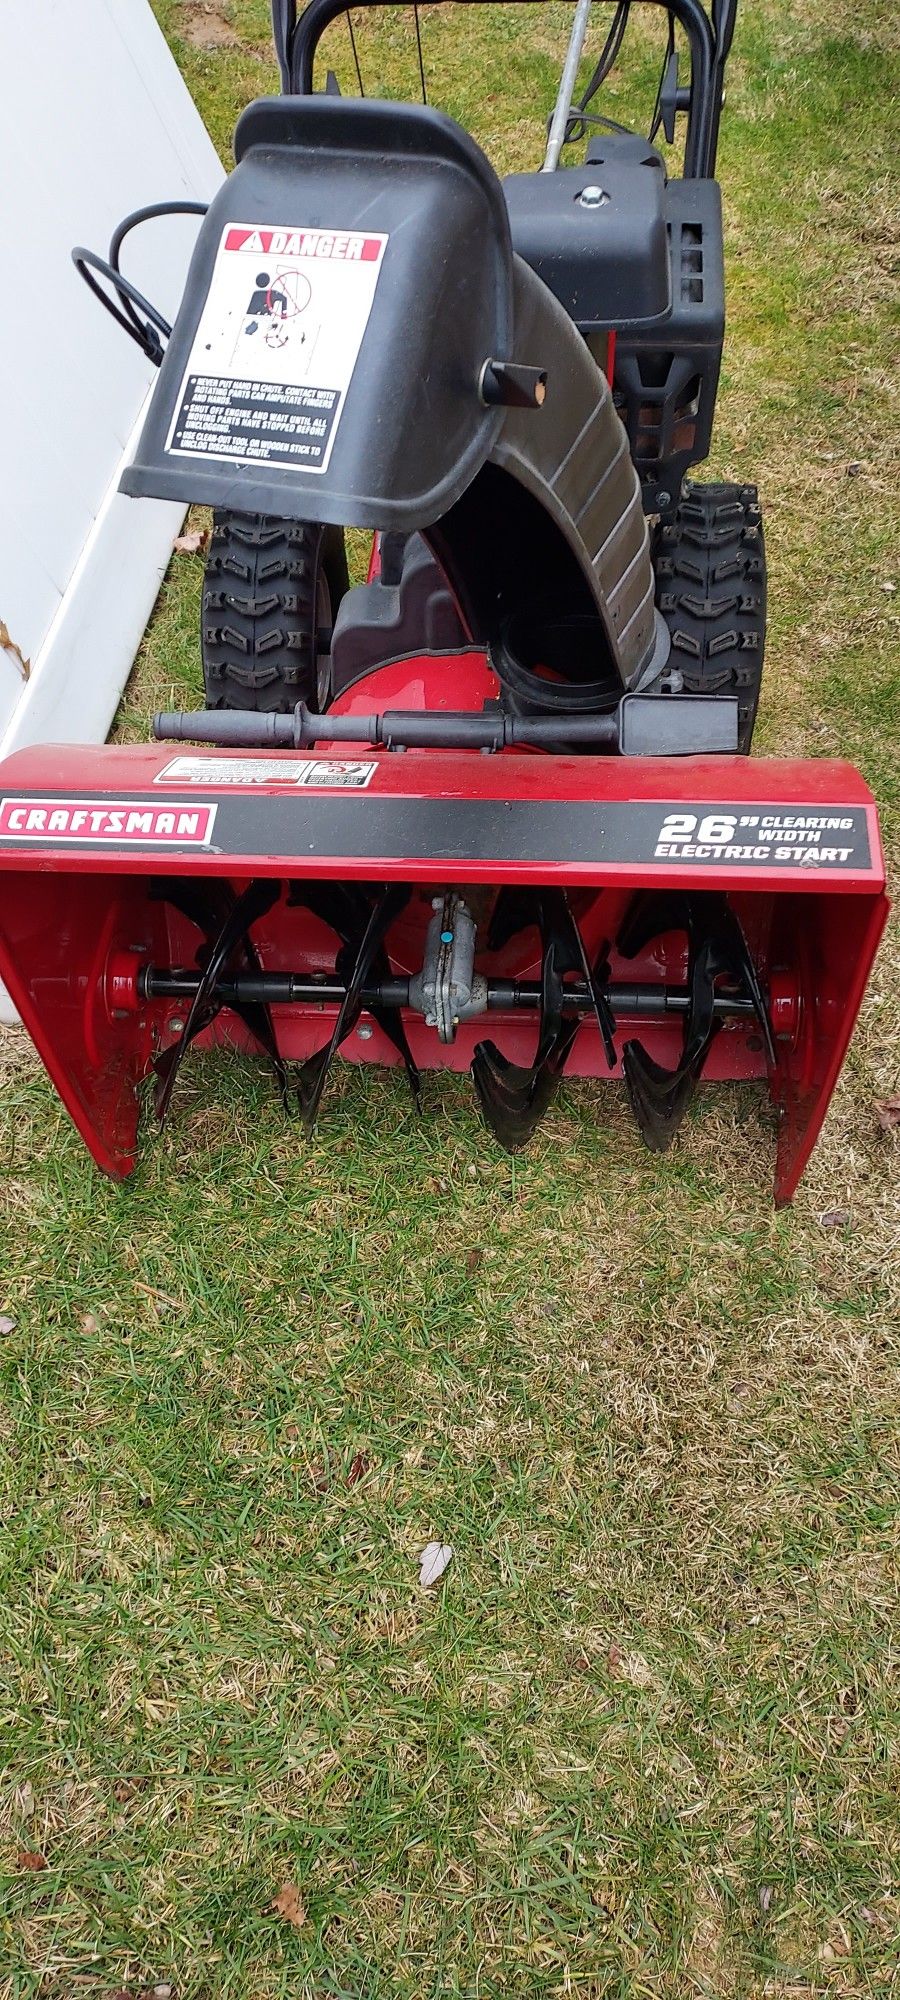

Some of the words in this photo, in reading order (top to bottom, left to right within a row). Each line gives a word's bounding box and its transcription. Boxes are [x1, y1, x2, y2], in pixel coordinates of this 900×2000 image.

[269, 231, 365, 261] DANGER
[192, 393, 207, 403] AND
[194, 385, 228, 396] ROTATING
[228, 388, 251, 399] PARTS
[251, 391, 266, 401] CAN
[265, 393, 303, 406] AMPUTATE
[302, 397, 333, 409] FINGERS
[197, 377, 219, 387] NEVER
[219, 380, 233, 389] PUT
[232, 381, 252, 391] HAND
[252, 383, 261, 392] IN
[260, 384, 284, 394] CHUTE.
[285, 386, 318, 398] CONTACT
[317, 390, 336, 401] WITH
[185, 420, 231, 433] UNCLOGGING.
[187, 412, 216, 423] MOVING
[216, 415, 241, 426] PARTS
[241, 418, 261, 429] HAVE
[261, 420, 296, 433] STOPPED
[296, 424, 326, 437] BEFORE
[189, 403, 210, 414] SHUT
[209, 405, 225, 415] OFF
[224, 407, 252, 418] ENGINE
[252, 410, 269, 420] AND
[269, 412, 289, 423] WAIT
[290, 415, 311, 426] UNTIL
[313, 417, 327, 427] ALL
[180, 439, 208, 450] UNCLOG
[207, 442, 247, 455] DISCHARGE
[246, 447, 271, 458] CHUTE.
[182, 430, 197, 441] USE
[196, 432, 232, 444] CLEAN-OUT
[232, 436, 249, 447] TOOL
[249, 438, 260, 448] OR
[260, 440, 290, 452] WOODEN
[290, 443, 311, 455] STICK
[310, 446, 321, 456] TO
[8, 808, 200, 835] CRAFTSMAN
[761, 816, 853, 830] CLEARING
[758, 829, 821, 842] WIDTH
[654, 843, 771, 860] ELECTRIC
[774, 847, 854, 862] START
